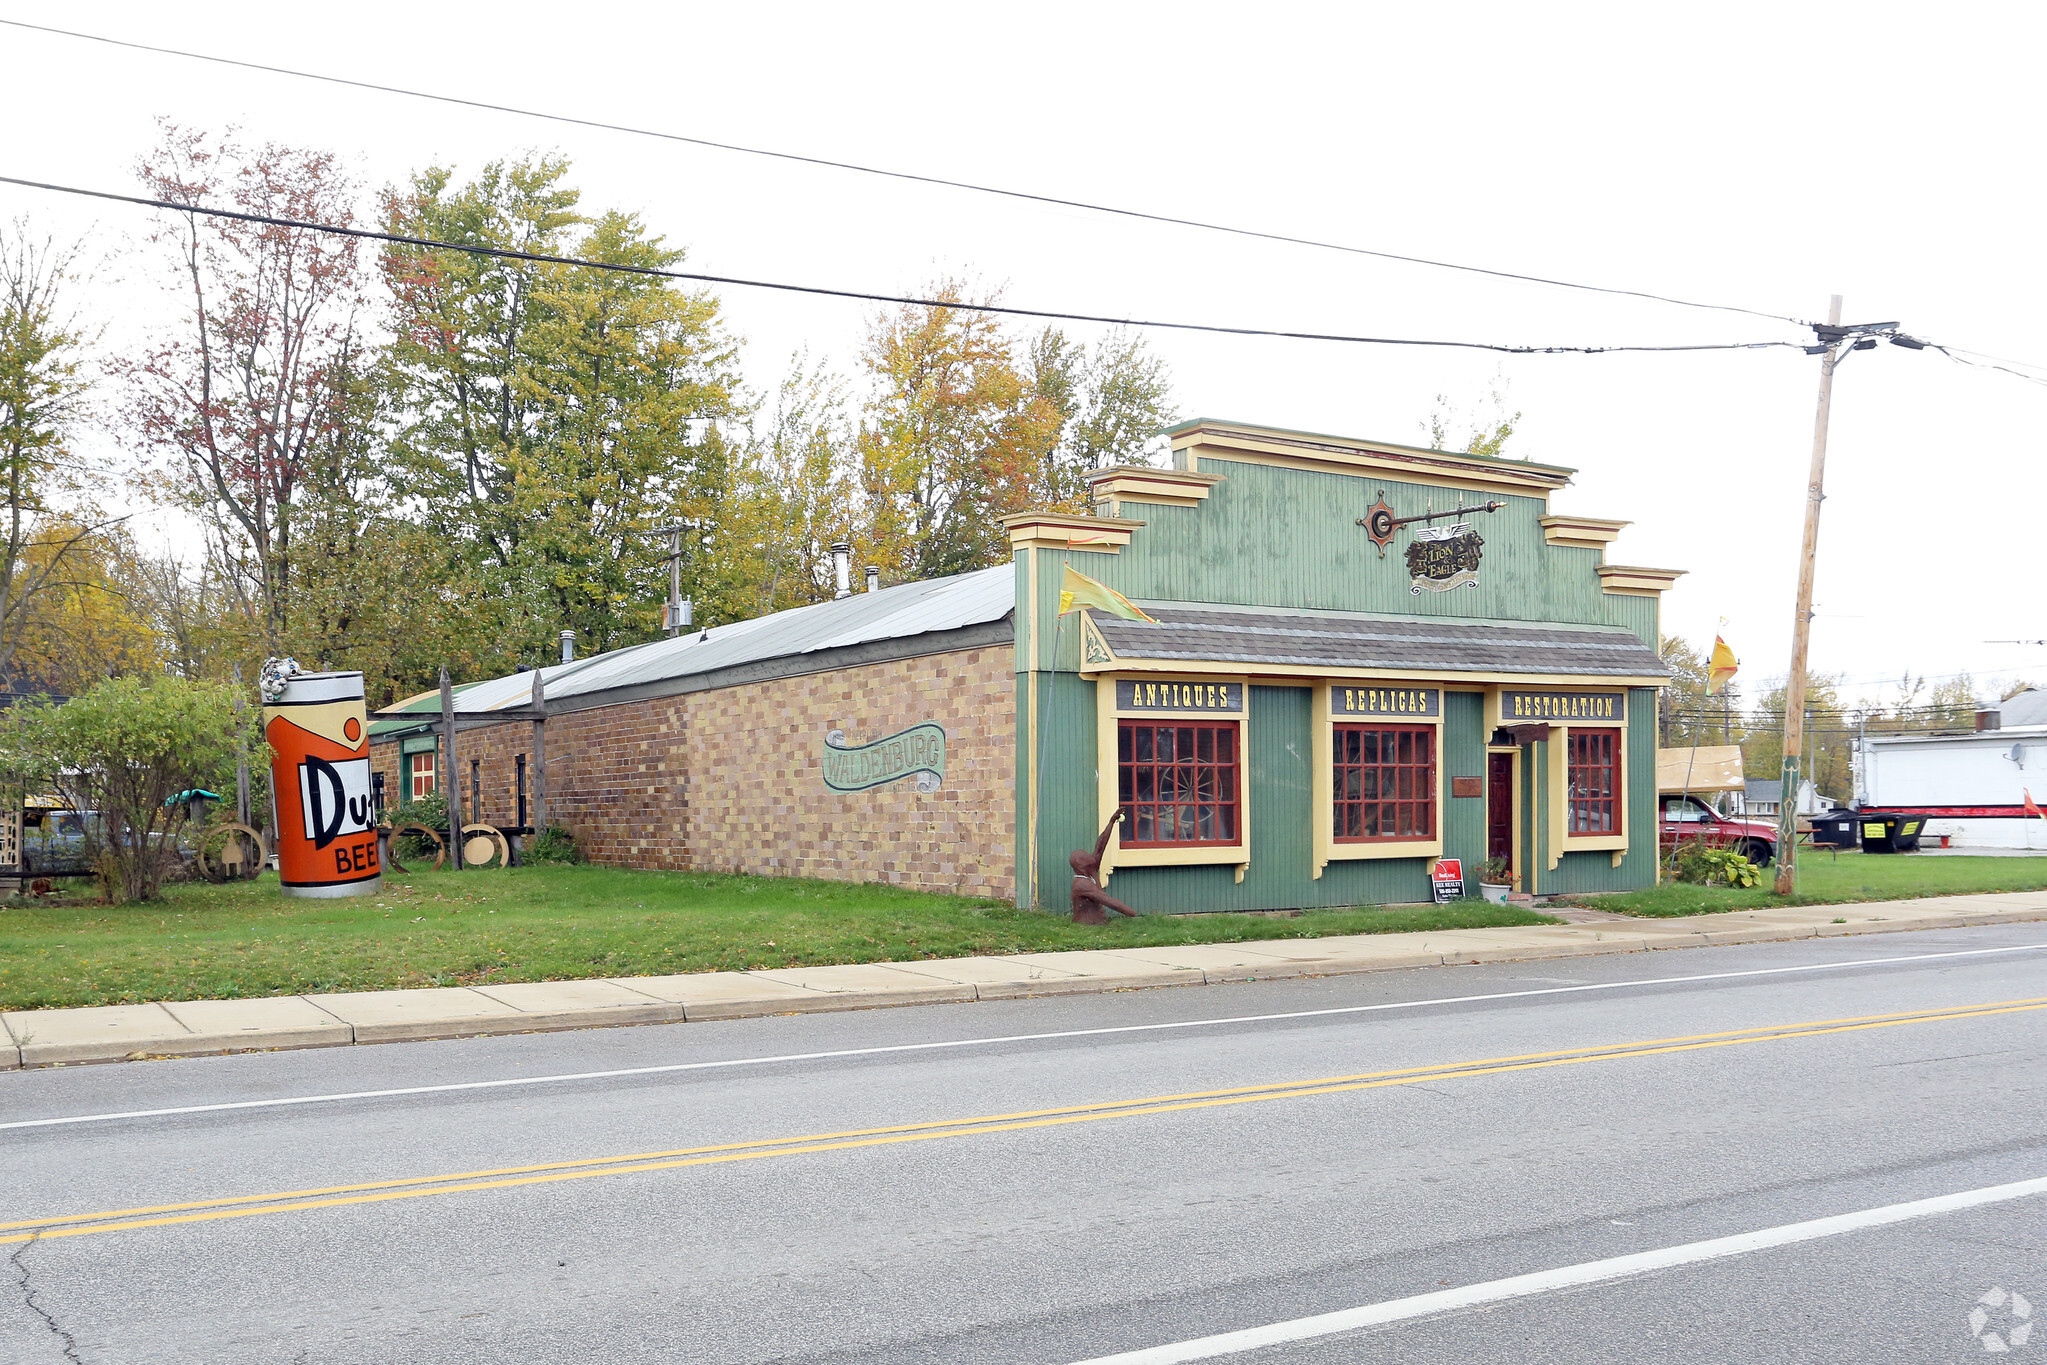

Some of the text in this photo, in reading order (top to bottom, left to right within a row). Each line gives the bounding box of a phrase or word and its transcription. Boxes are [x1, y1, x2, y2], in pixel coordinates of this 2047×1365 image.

[1132, 683, 1228, 708] ANTIQUES
[1344, 689, 1426, 713] REPLICAS
[1513, 695, 1613, 717] RESTORATION
[335, 839, 379, 875] BEE
